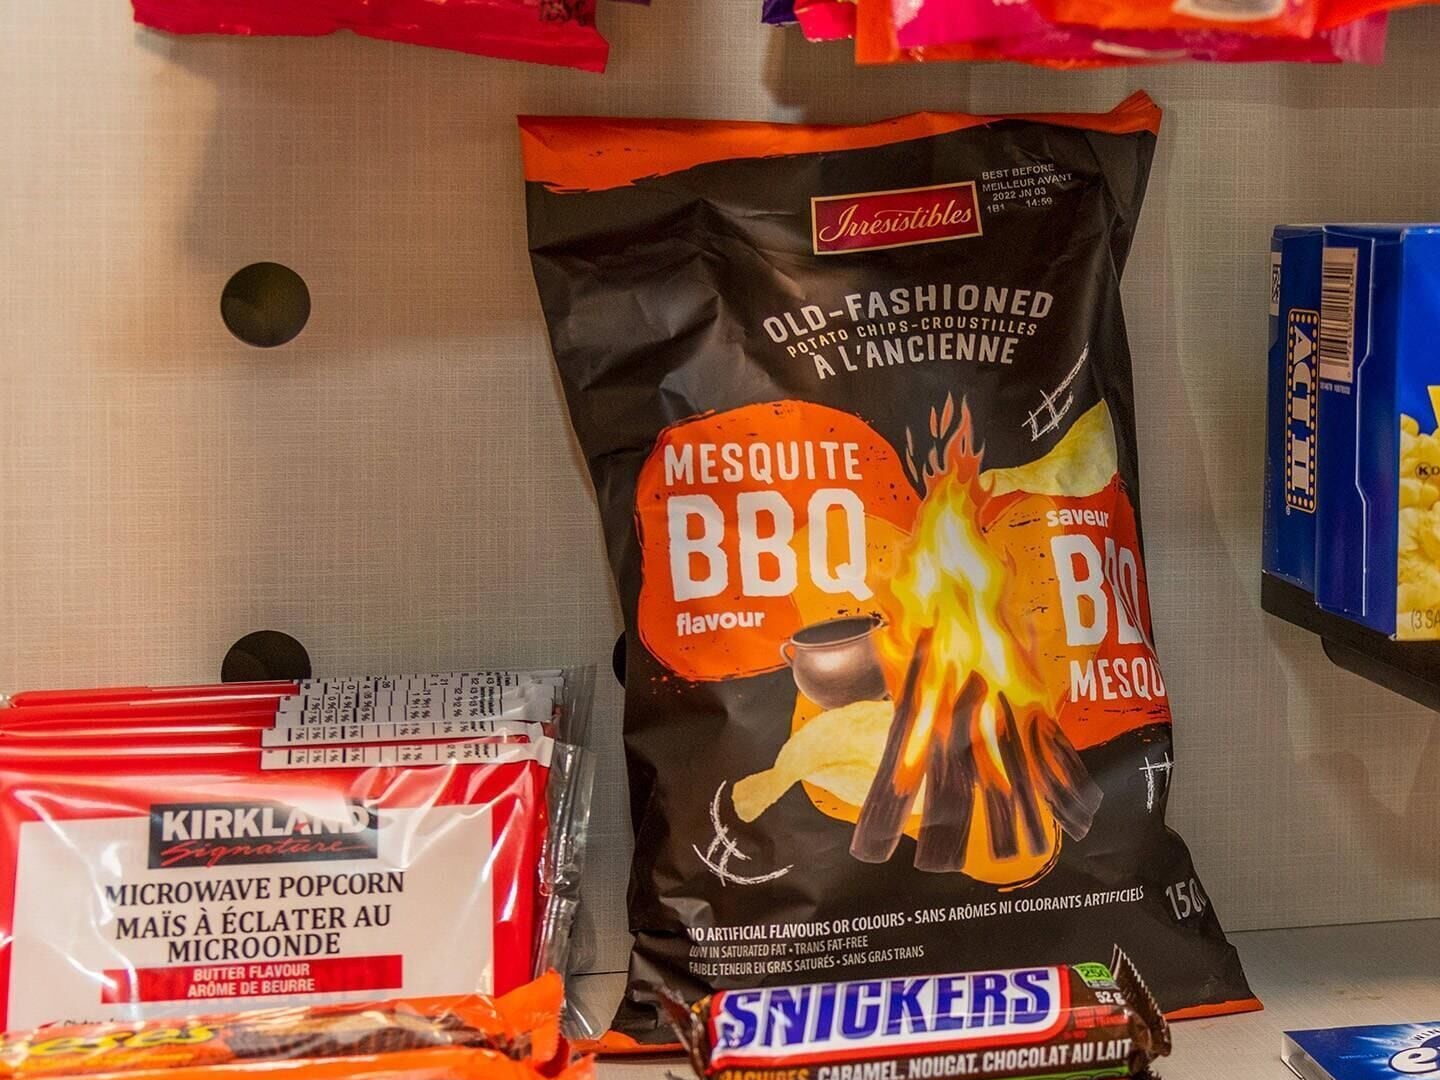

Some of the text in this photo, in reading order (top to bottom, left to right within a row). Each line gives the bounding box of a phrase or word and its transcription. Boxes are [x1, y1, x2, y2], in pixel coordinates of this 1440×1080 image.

[982, 163, 1055, 180] BEST BEFORE
[982, 173, 1072, 192] MEILLEUR AVANT
[993, 187, 1046, 201] 2022 JN 03
[762, 283, 1053, 344] OLD-FASHIONED
[786, 328, 849, 358] POTATO
[810, 333, 1019, 380] À L'ANCIENNE
[664, 442, 863, 487] MESQUITE
[1046, 509, 1109, 528] saveur
[667, 488, 874, 602] BBQ
[676, 609, 765, 636] flavour
[161, 803, 371, 841] KIRKLAND
[160, 838, 371, 869] Signature
[104, 871, 405, 907] MICROWAVE POPCORN
[116, 904, 392, 941] MAÏS À ÉCLATER AU
[707, 925, 767, 941] ARTIFICIAL
[769, 921, 830, 939] FLAVOURS
[833, 919, 849, 933] OR
[852, 912, 905, 931] COLOURS
[914, 908, 946, 924] SANS
[949, 901, 998, 921] ARÔMES
[999, 902, 1012, 915] NI
[1015, 895, 1081, 913] COLORANTS
[1084, 885, 1144, 907] ARTIFICIELS
[167, 932, 342, 964] MICROONDE
[689, 945, 925, 975] FAIBLE TENEUR EN GRAS SATURÉS SANS GRAS TRANS
[709, 945, 720, 958] IN
[721, 943, 769, 958] SATURATED
[771, 942, 787, 956] FAT
[794, 940, 825, 955] TRANS
[827, 935, 868, 952] FAT-FREE
[187, 977, 316, 997] ARÔME DE BEURRE
[193, 963, 310, 982] BUTTER FLAVOUR
[720, 968, 1051, 1048] SNICKERS
[909, 1052, 979, 1080] NOUGAT.
[983, 1045, 1070, 1072] CHOCOLAT
[1072, 1042, 1094, 1065] AU
[1096, 1038, 1132, 1061] LAIT
